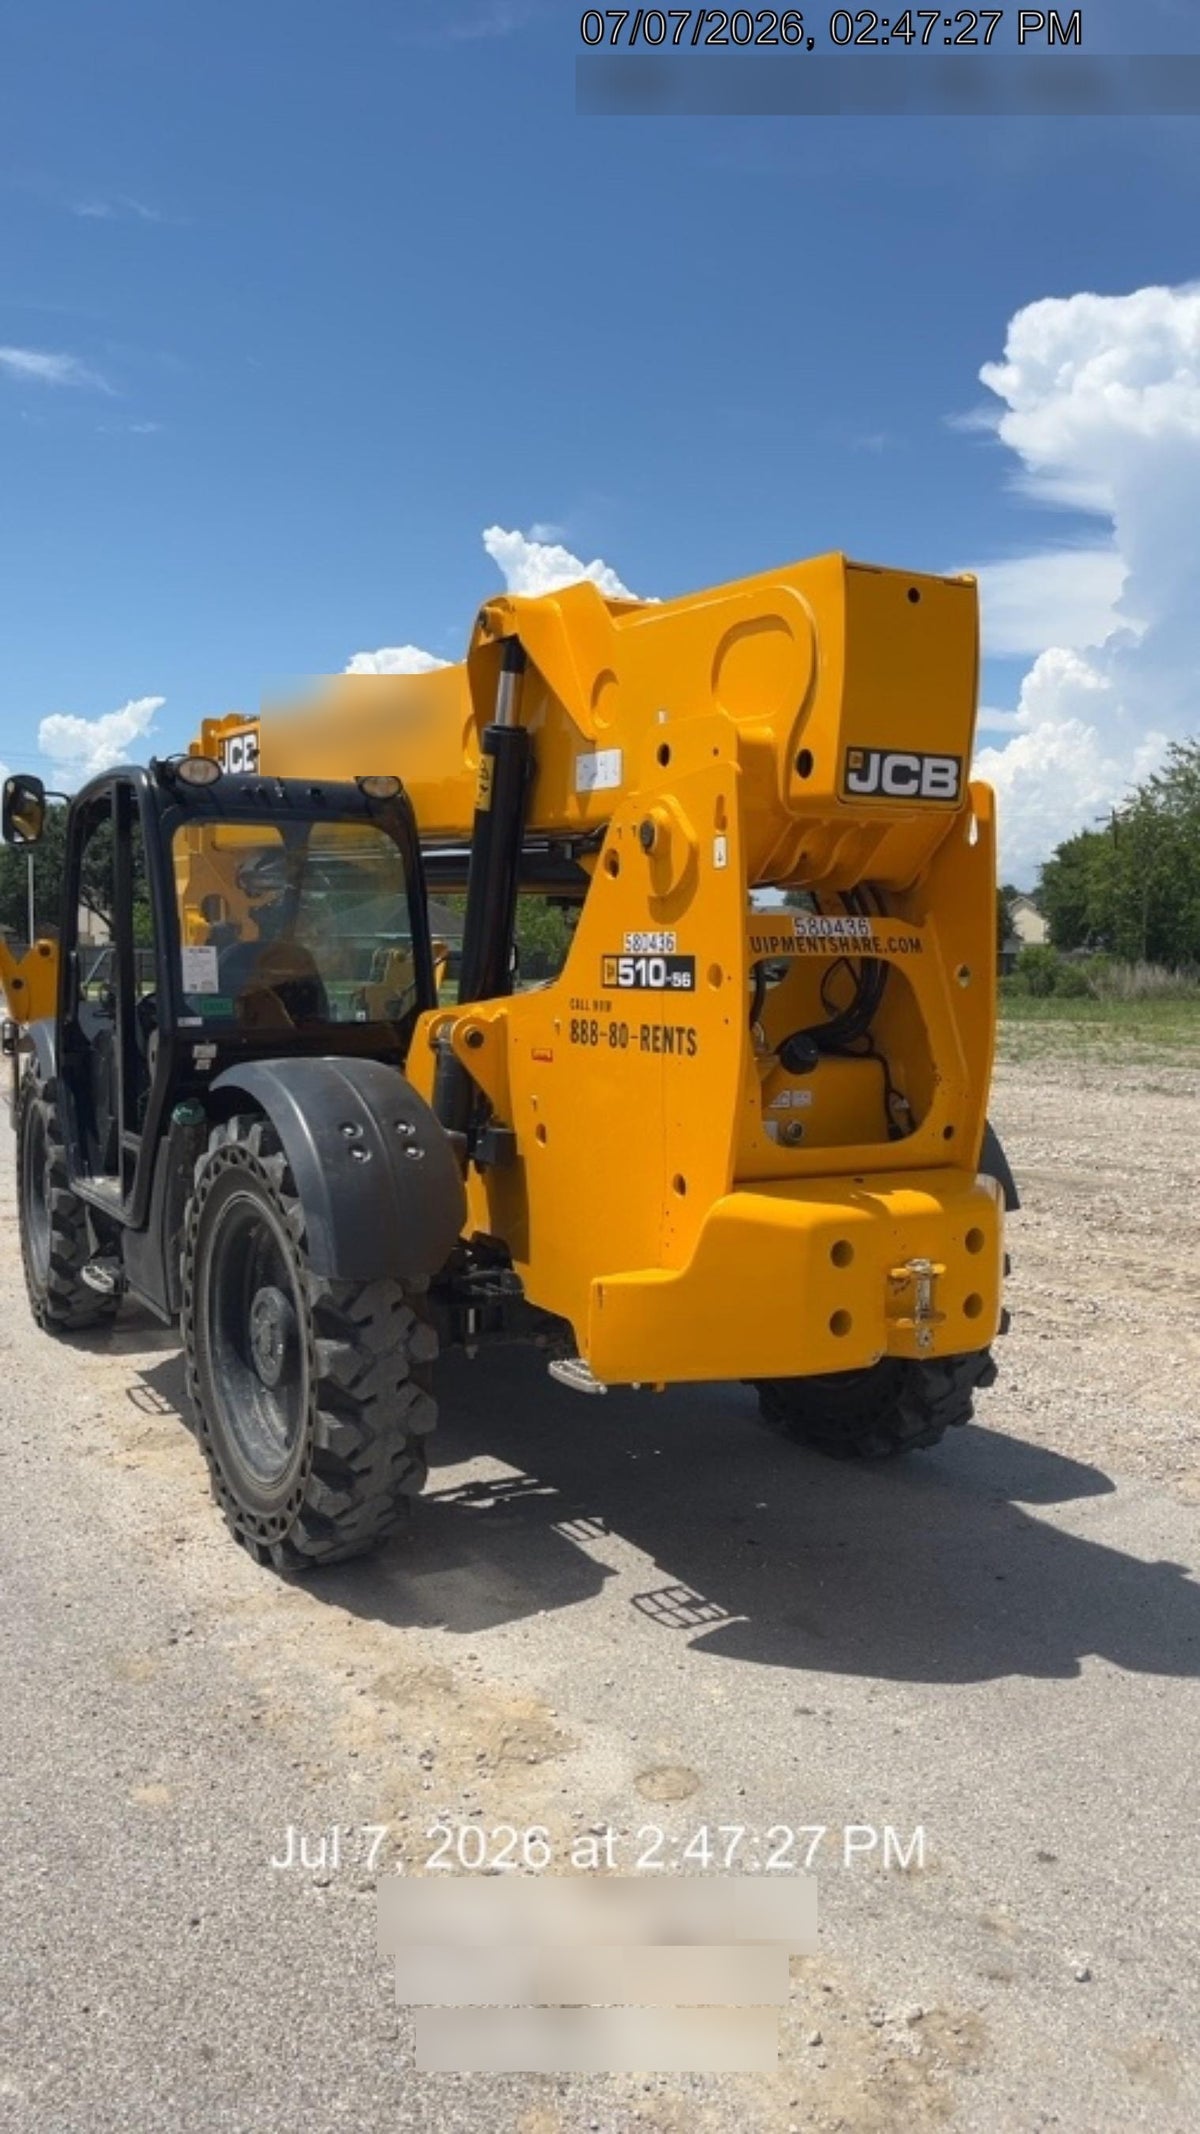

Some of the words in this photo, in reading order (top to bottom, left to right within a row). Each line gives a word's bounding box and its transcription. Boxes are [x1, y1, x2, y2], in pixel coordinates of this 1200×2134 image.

[847, 752, 959, 798] JCB
[794, 918, 870, 936] 580436
[750, 935, 923, 954] UIPMENTSHARE.COM
[617, 957, 692, 989] 510-56
[570, 1018, 698, 1057] 888-80-RENTS
